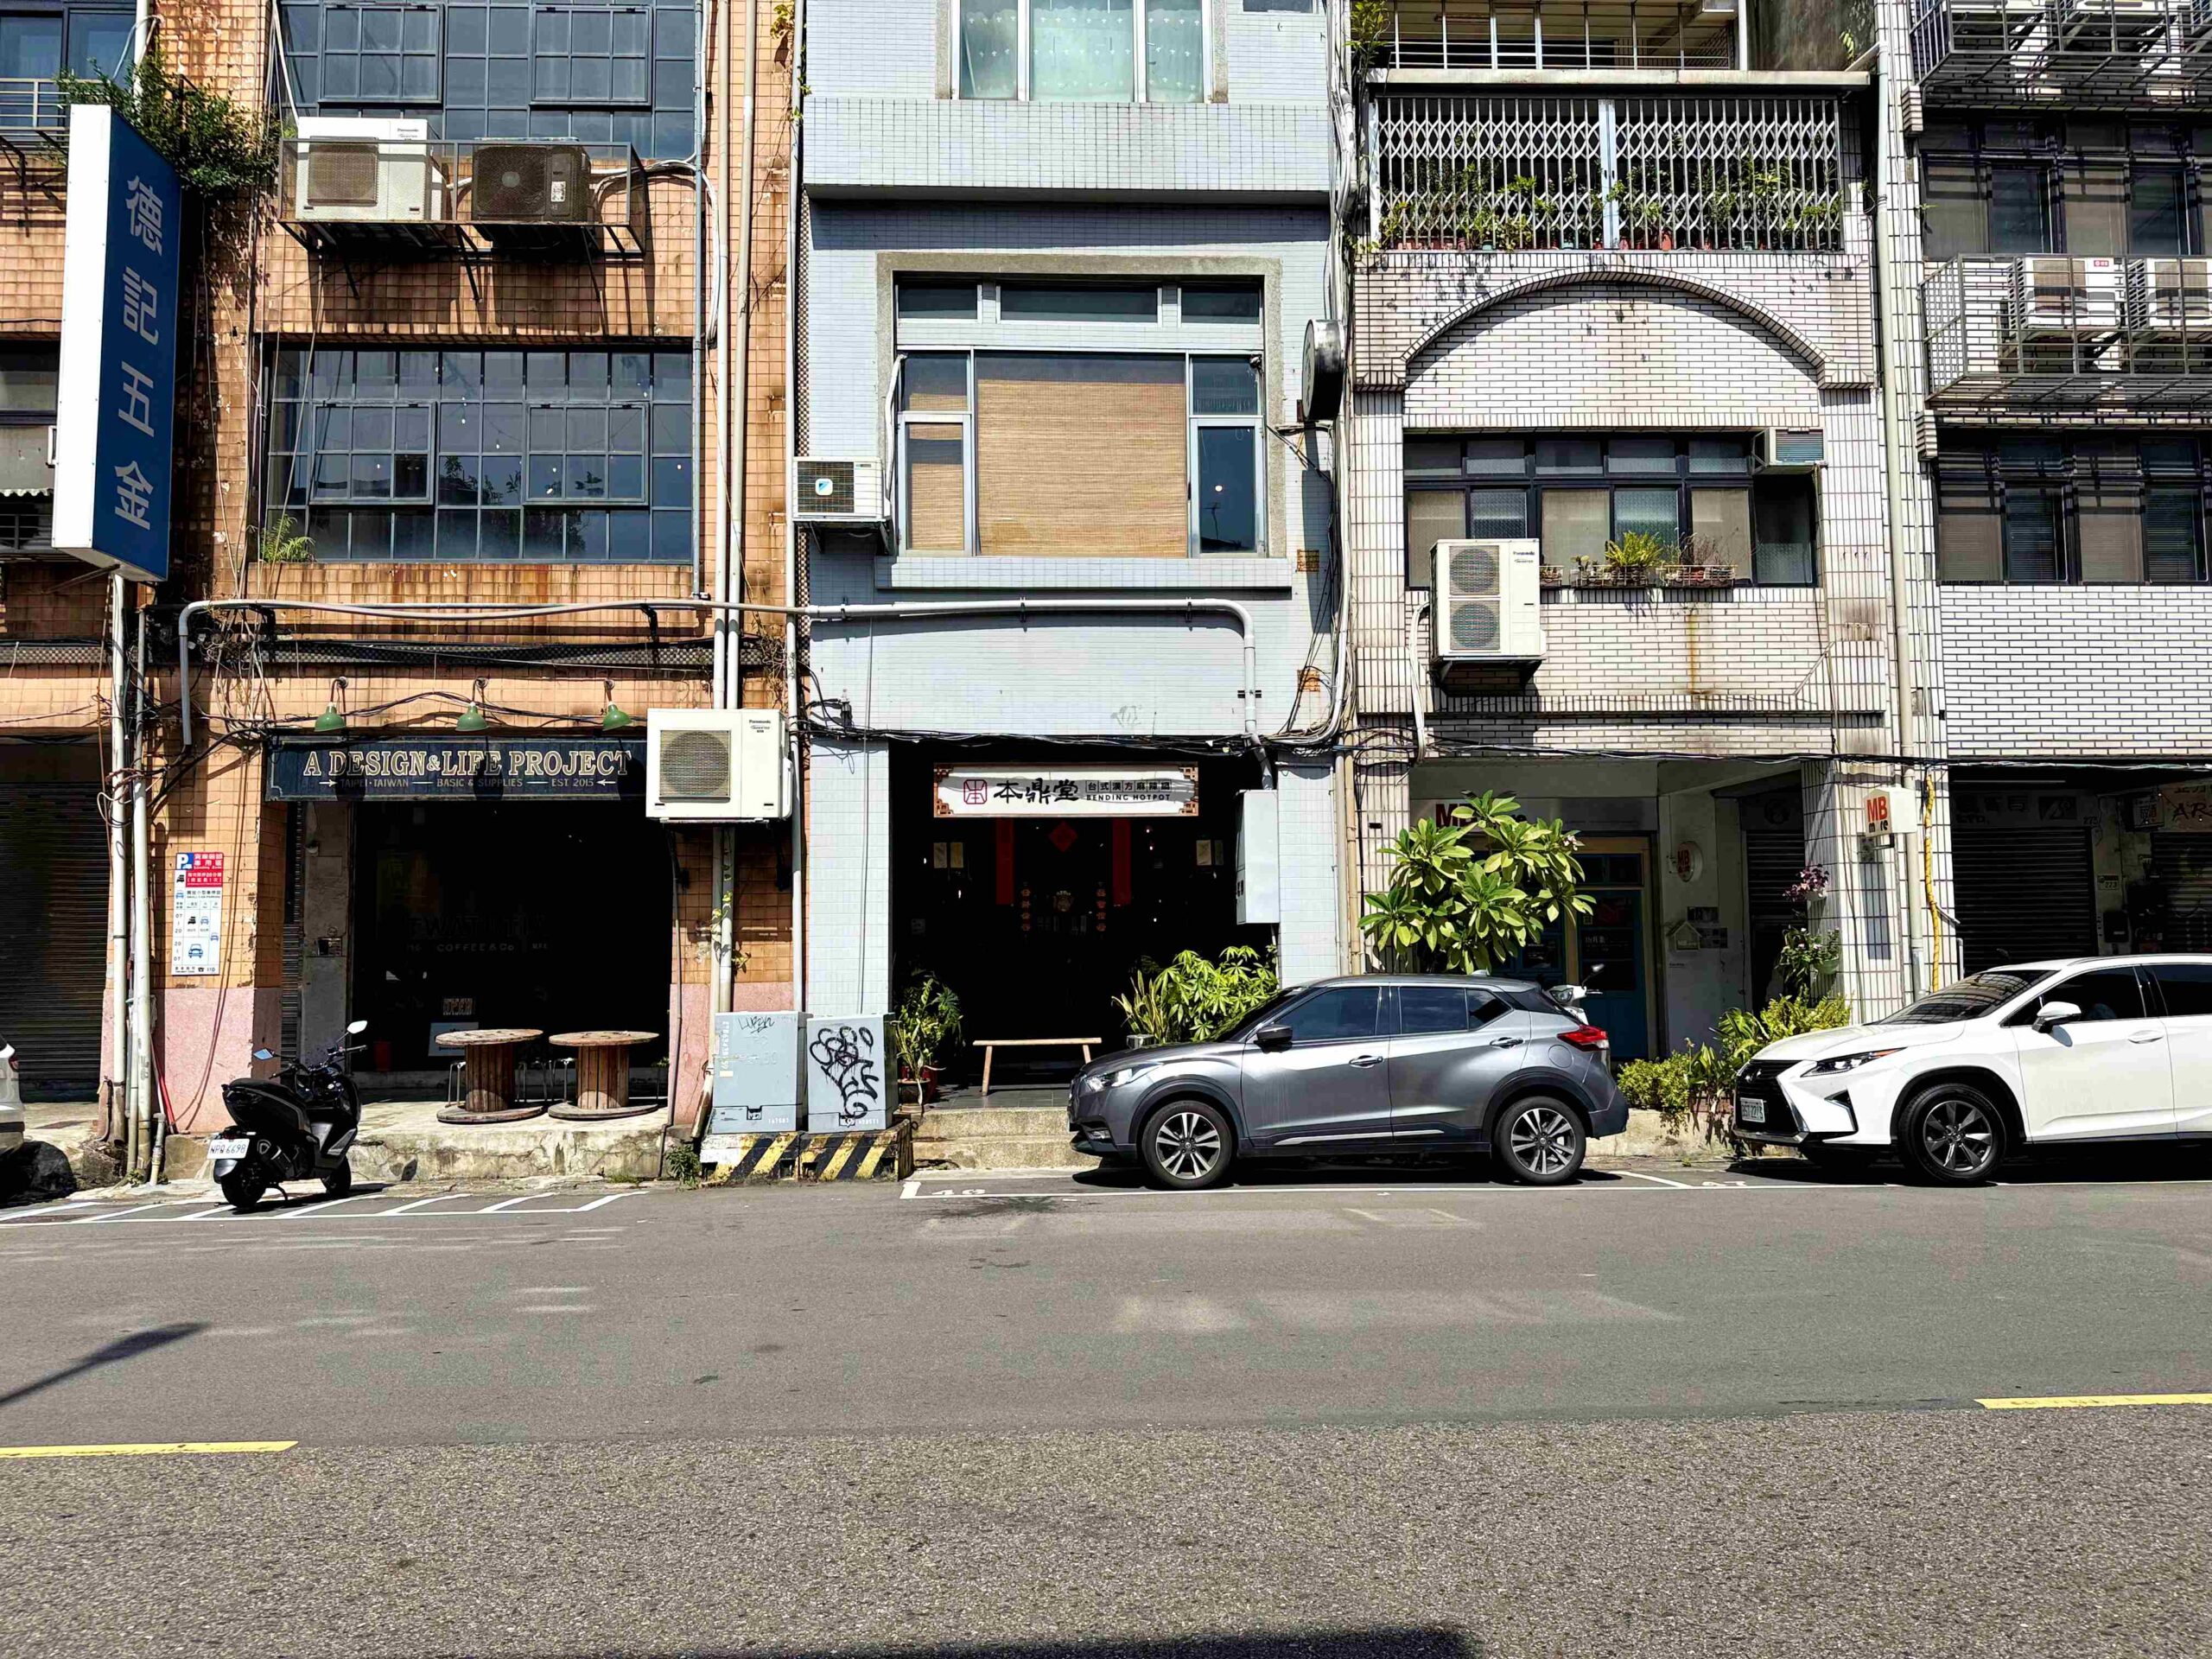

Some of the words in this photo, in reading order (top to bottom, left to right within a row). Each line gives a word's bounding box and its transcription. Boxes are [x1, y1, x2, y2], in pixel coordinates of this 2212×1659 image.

[113, 175, 163, 531] 德記五金
[303, 751, 321, 776] A
[508, 750, 632, 776] PROJECT
[436, 779, 464, 788] BASIC
[478, 779, 523, 788] SUPPLIES
[573, 779, 594, 788] 2015
[993, 777, 1079, 805] 本鼎堂
[1866, 796, 1888, 822] MB
[176, 854, 189, 869] P
